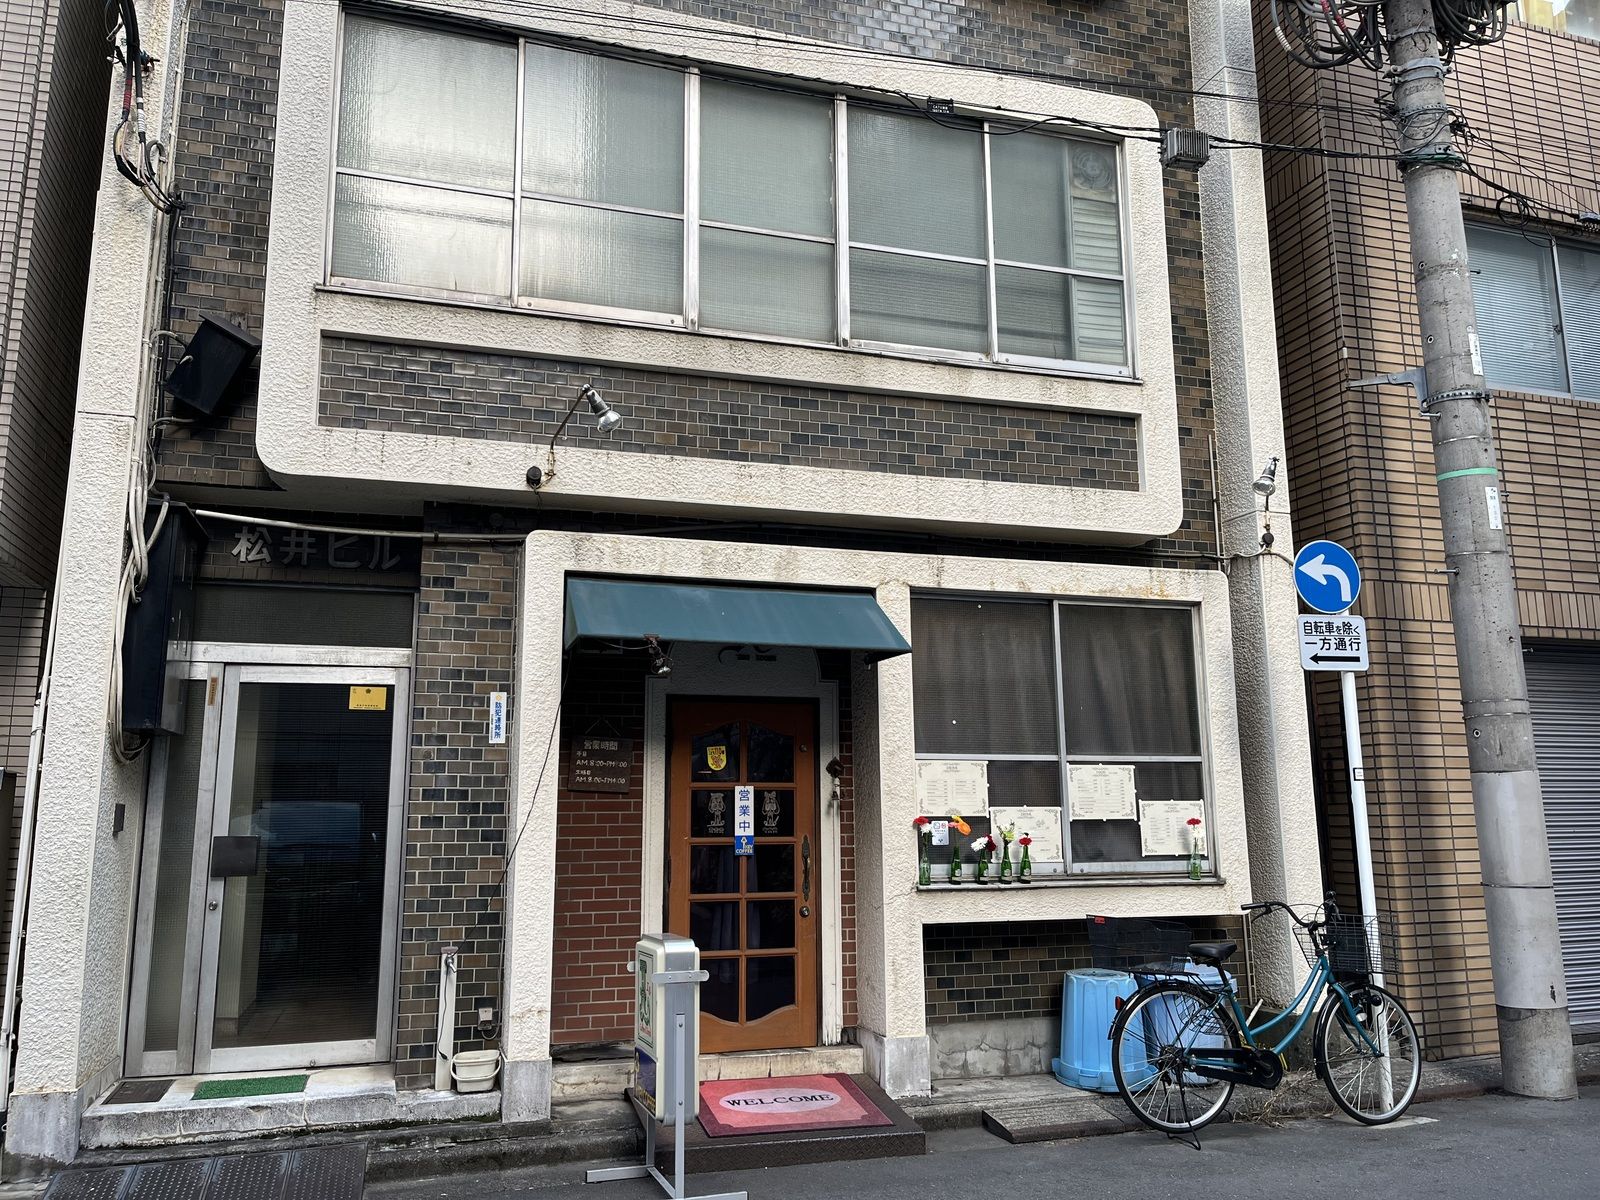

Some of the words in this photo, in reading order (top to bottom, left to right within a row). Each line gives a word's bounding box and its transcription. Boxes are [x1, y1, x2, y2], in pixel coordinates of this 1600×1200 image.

[231, 526, 400, 570] 松井ビル
[1303, 621, 1360, 635] 自転車を除く
[1304, 637, 1361, 651] 一方通行
[494, 701, 502, 739] 防犯連絡所
[583, 739, 618, 751] 営業時間
[738, 789, 751, 833] 営業中
[726, 1094, 834, 1107] WELCOME
